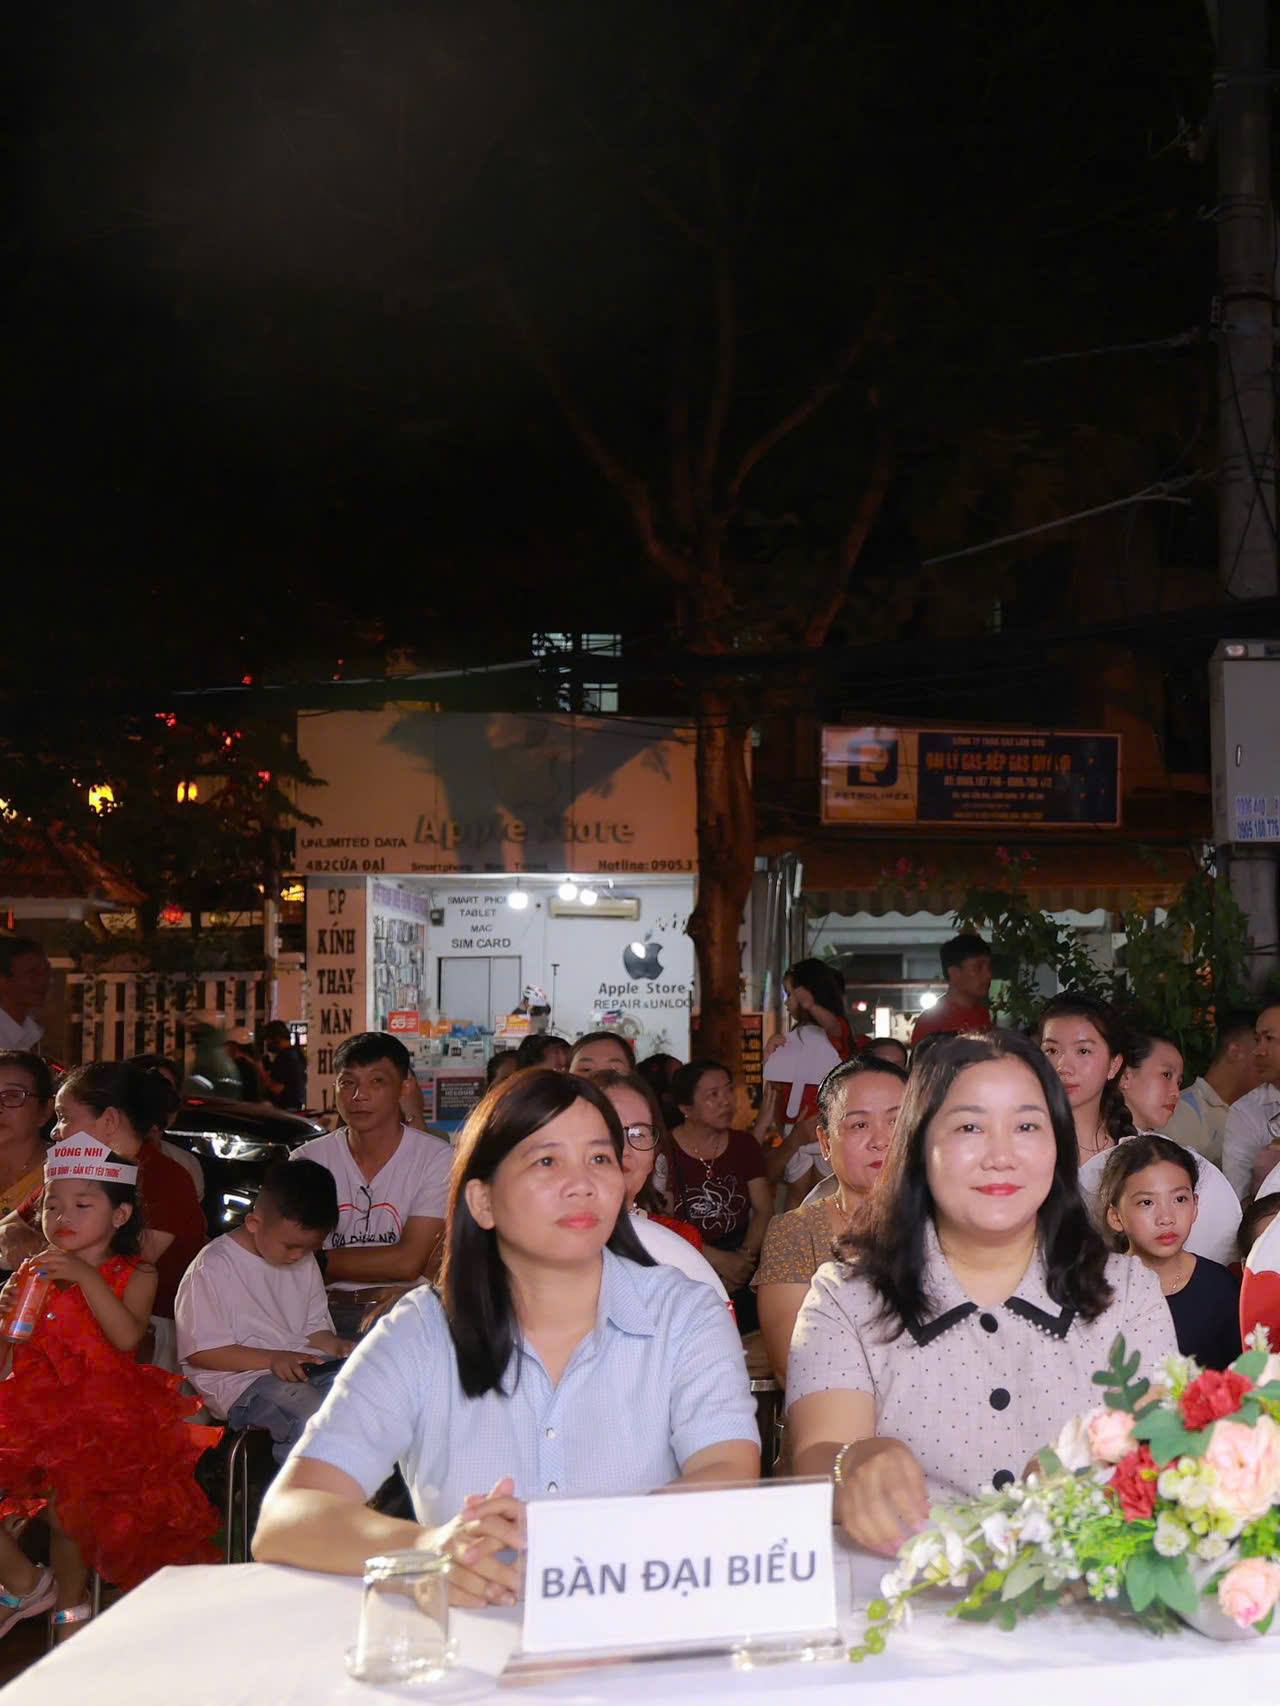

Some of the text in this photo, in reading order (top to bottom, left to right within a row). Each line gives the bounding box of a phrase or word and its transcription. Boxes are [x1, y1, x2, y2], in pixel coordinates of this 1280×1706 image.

[301, 838, 407, 849] UNLIMITED DATA
[447, 895, 479, 904] SMART
[460, 909, 497, 917] TABLET
[470, 925, 494, 933] MAC
[317, 921, 356, 955] KÍNH
[451, 938, 511, 949] SIM CARD
[317, 968, 356, 995] THAY
[598, 982, 686, 996] Apple Store
[594, 999, 641, 1009] REPAIR
[320, 1002, 352, 1035] MÀN
[84, 1147, 103, 1158] NHI
[541, 1537, 817, 1599] BÀN ĐẠI BIỂU
